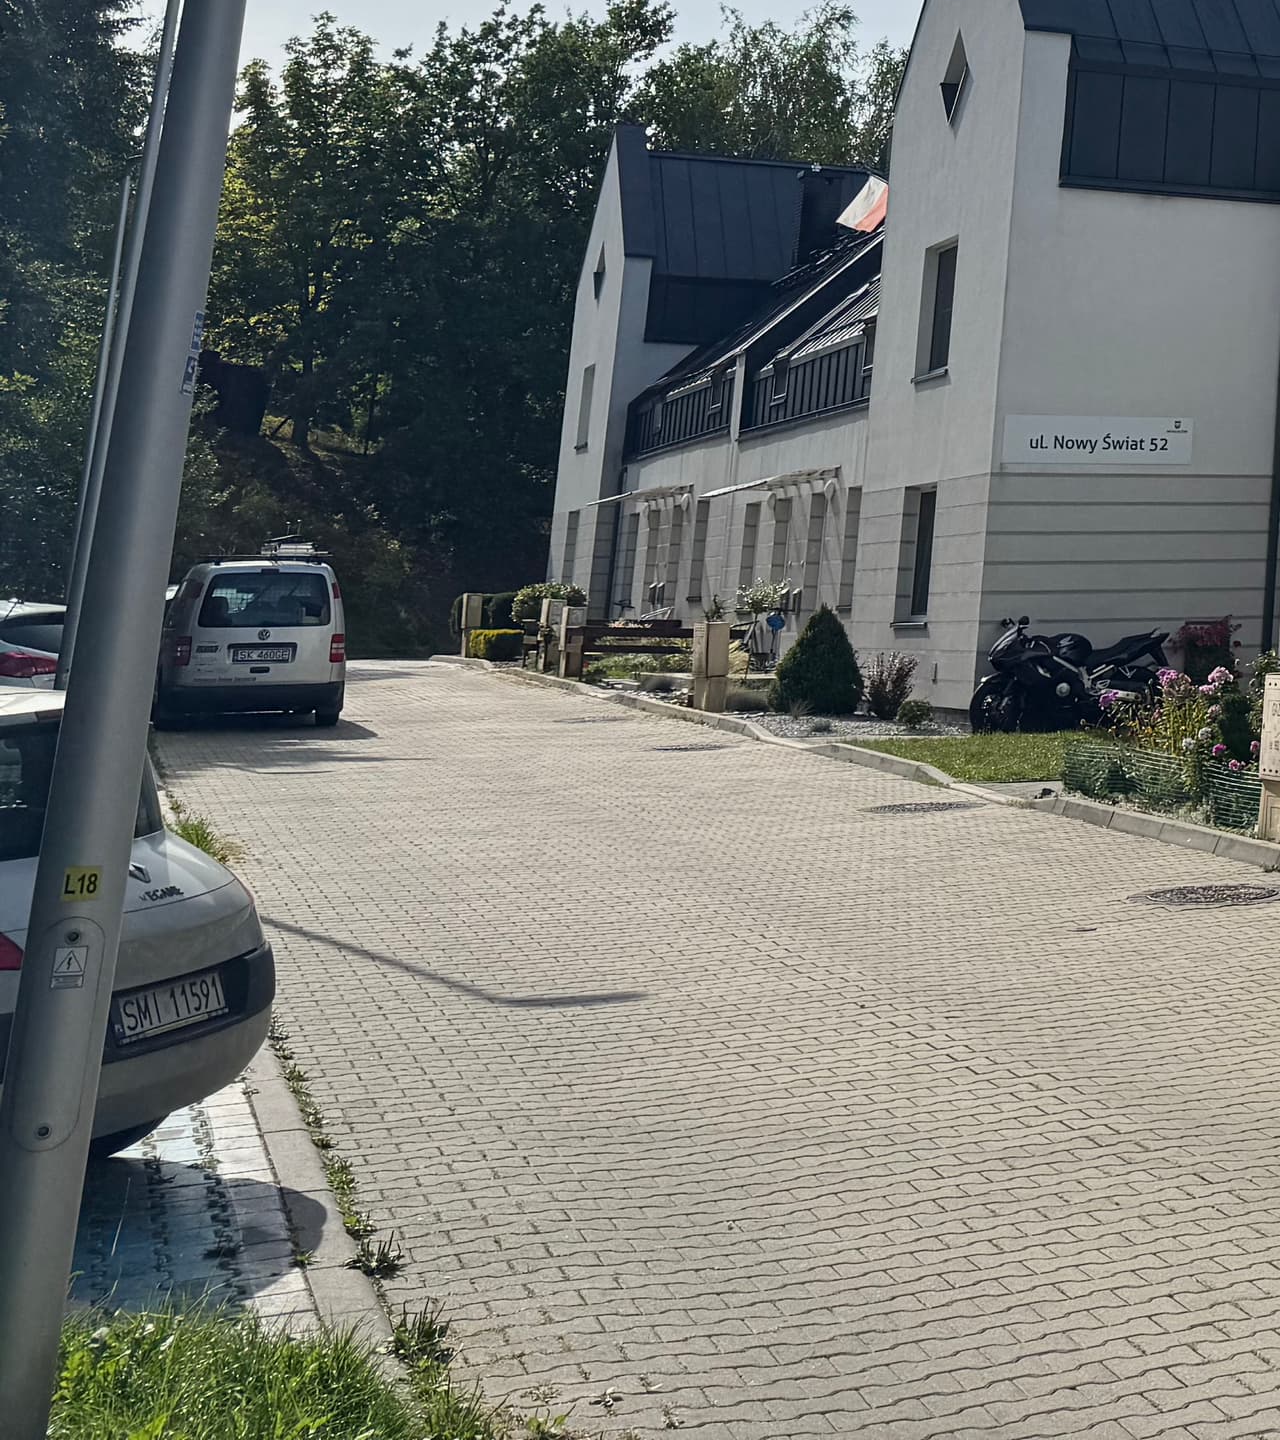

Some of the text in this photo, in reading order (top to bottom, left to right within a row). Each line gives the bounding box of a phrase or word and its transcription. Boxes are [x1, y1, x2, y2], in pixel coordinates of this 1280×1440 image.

[1029, 433, 1169, 454] ul. Nowy Świat 52
[64, 873, 99, 895] L18
[122, 975, 221, 1031] SMI 11591
